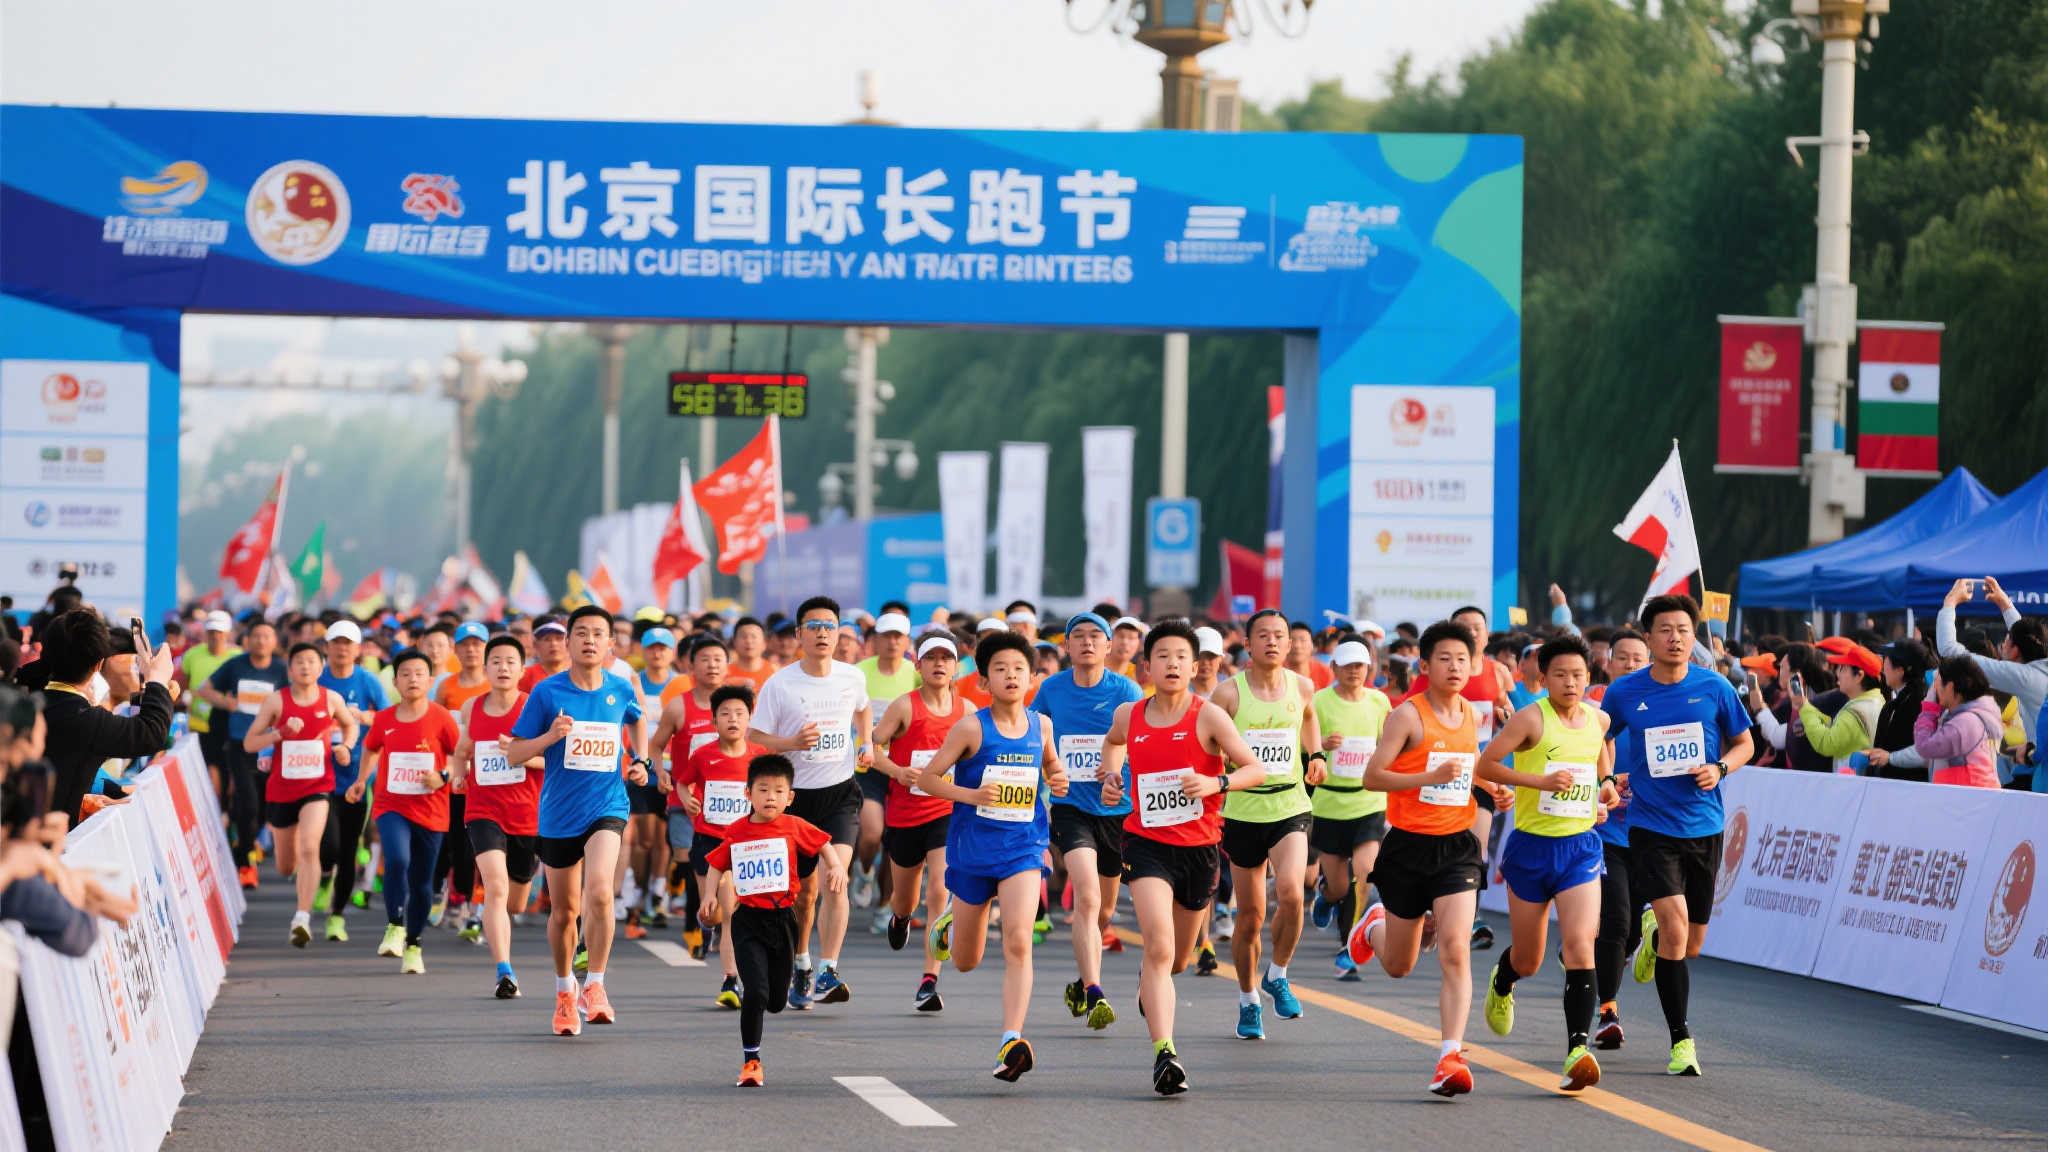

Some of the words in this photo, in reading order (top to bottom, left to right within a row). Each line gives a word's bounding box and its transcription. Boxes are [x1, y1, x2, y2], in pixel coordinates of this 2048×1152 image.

[506, 160, 1137, 248] 北京国际长跑节
